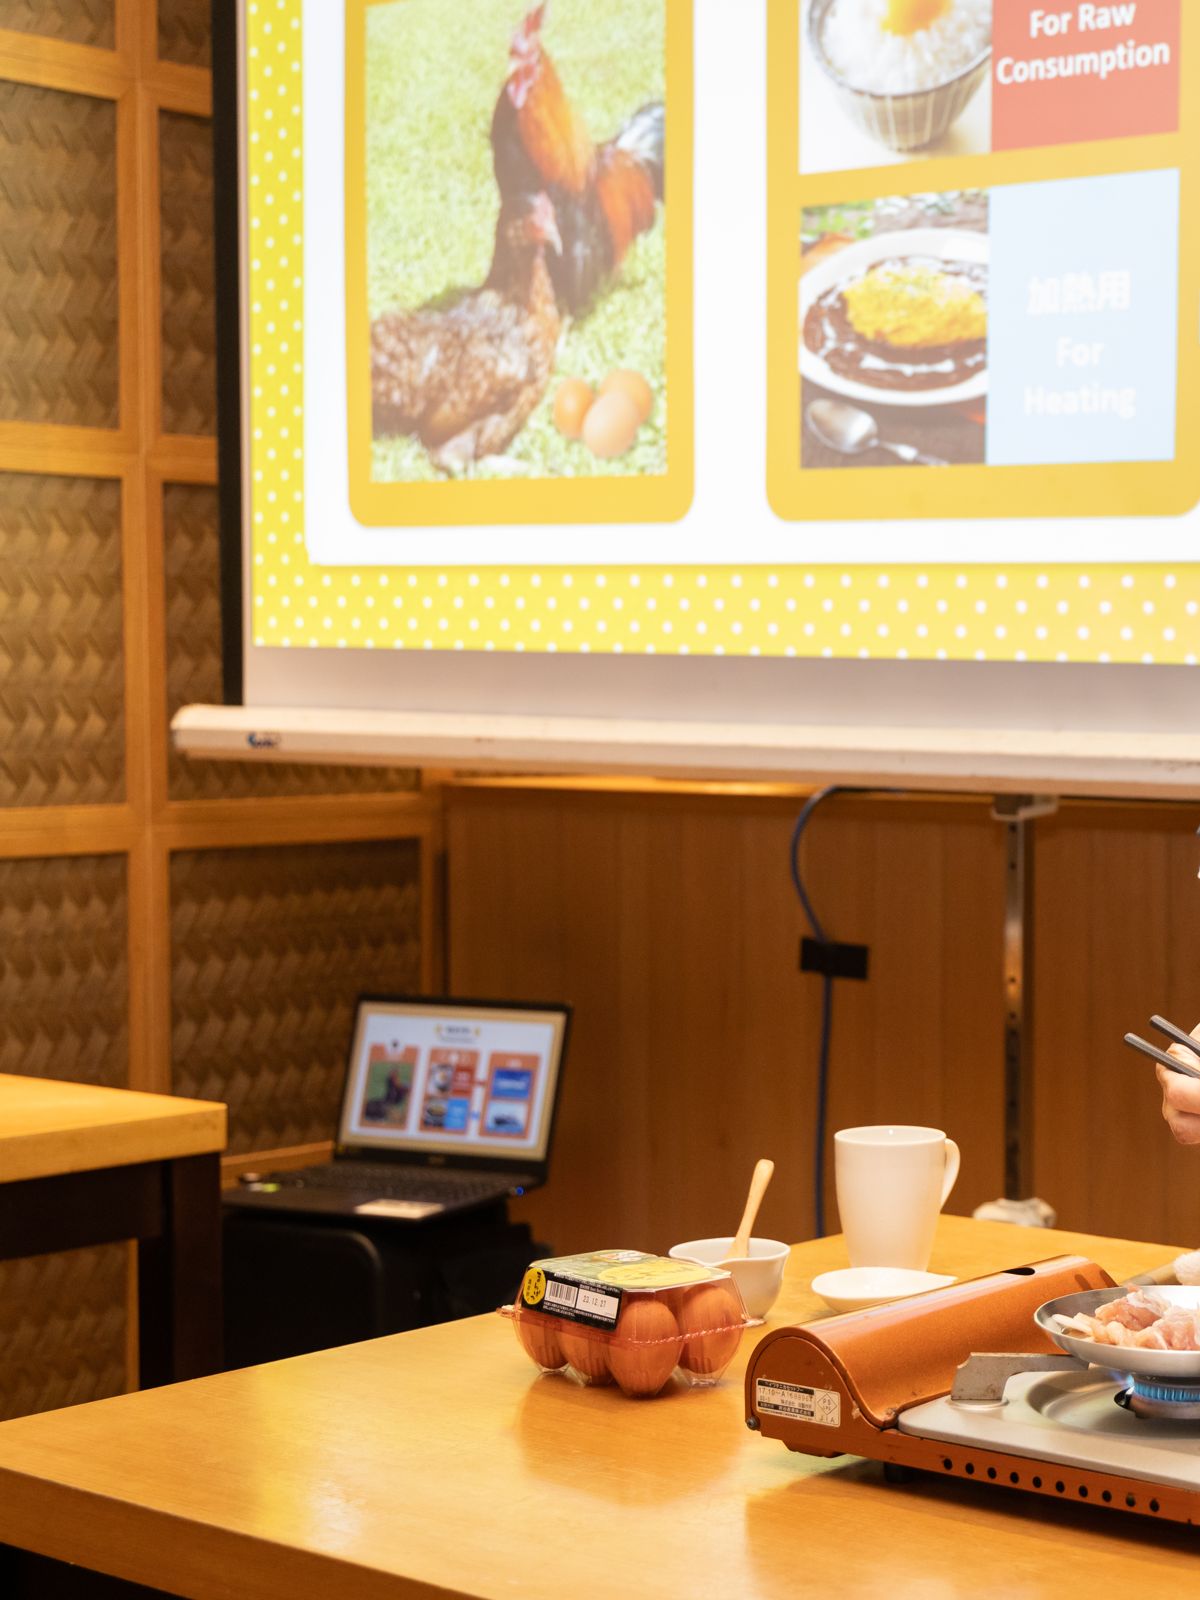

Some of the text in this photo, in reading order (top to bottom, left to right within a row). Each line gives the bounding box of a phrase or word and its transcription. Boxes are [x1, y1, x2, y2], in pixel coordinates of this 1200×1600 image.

[1029, 2, 1136, 38] For Raw
[996, 39, 1170, 85] Consumption
[1056, 335, 1105, 368] For
[1024, 381, 1136, 420] Heating
